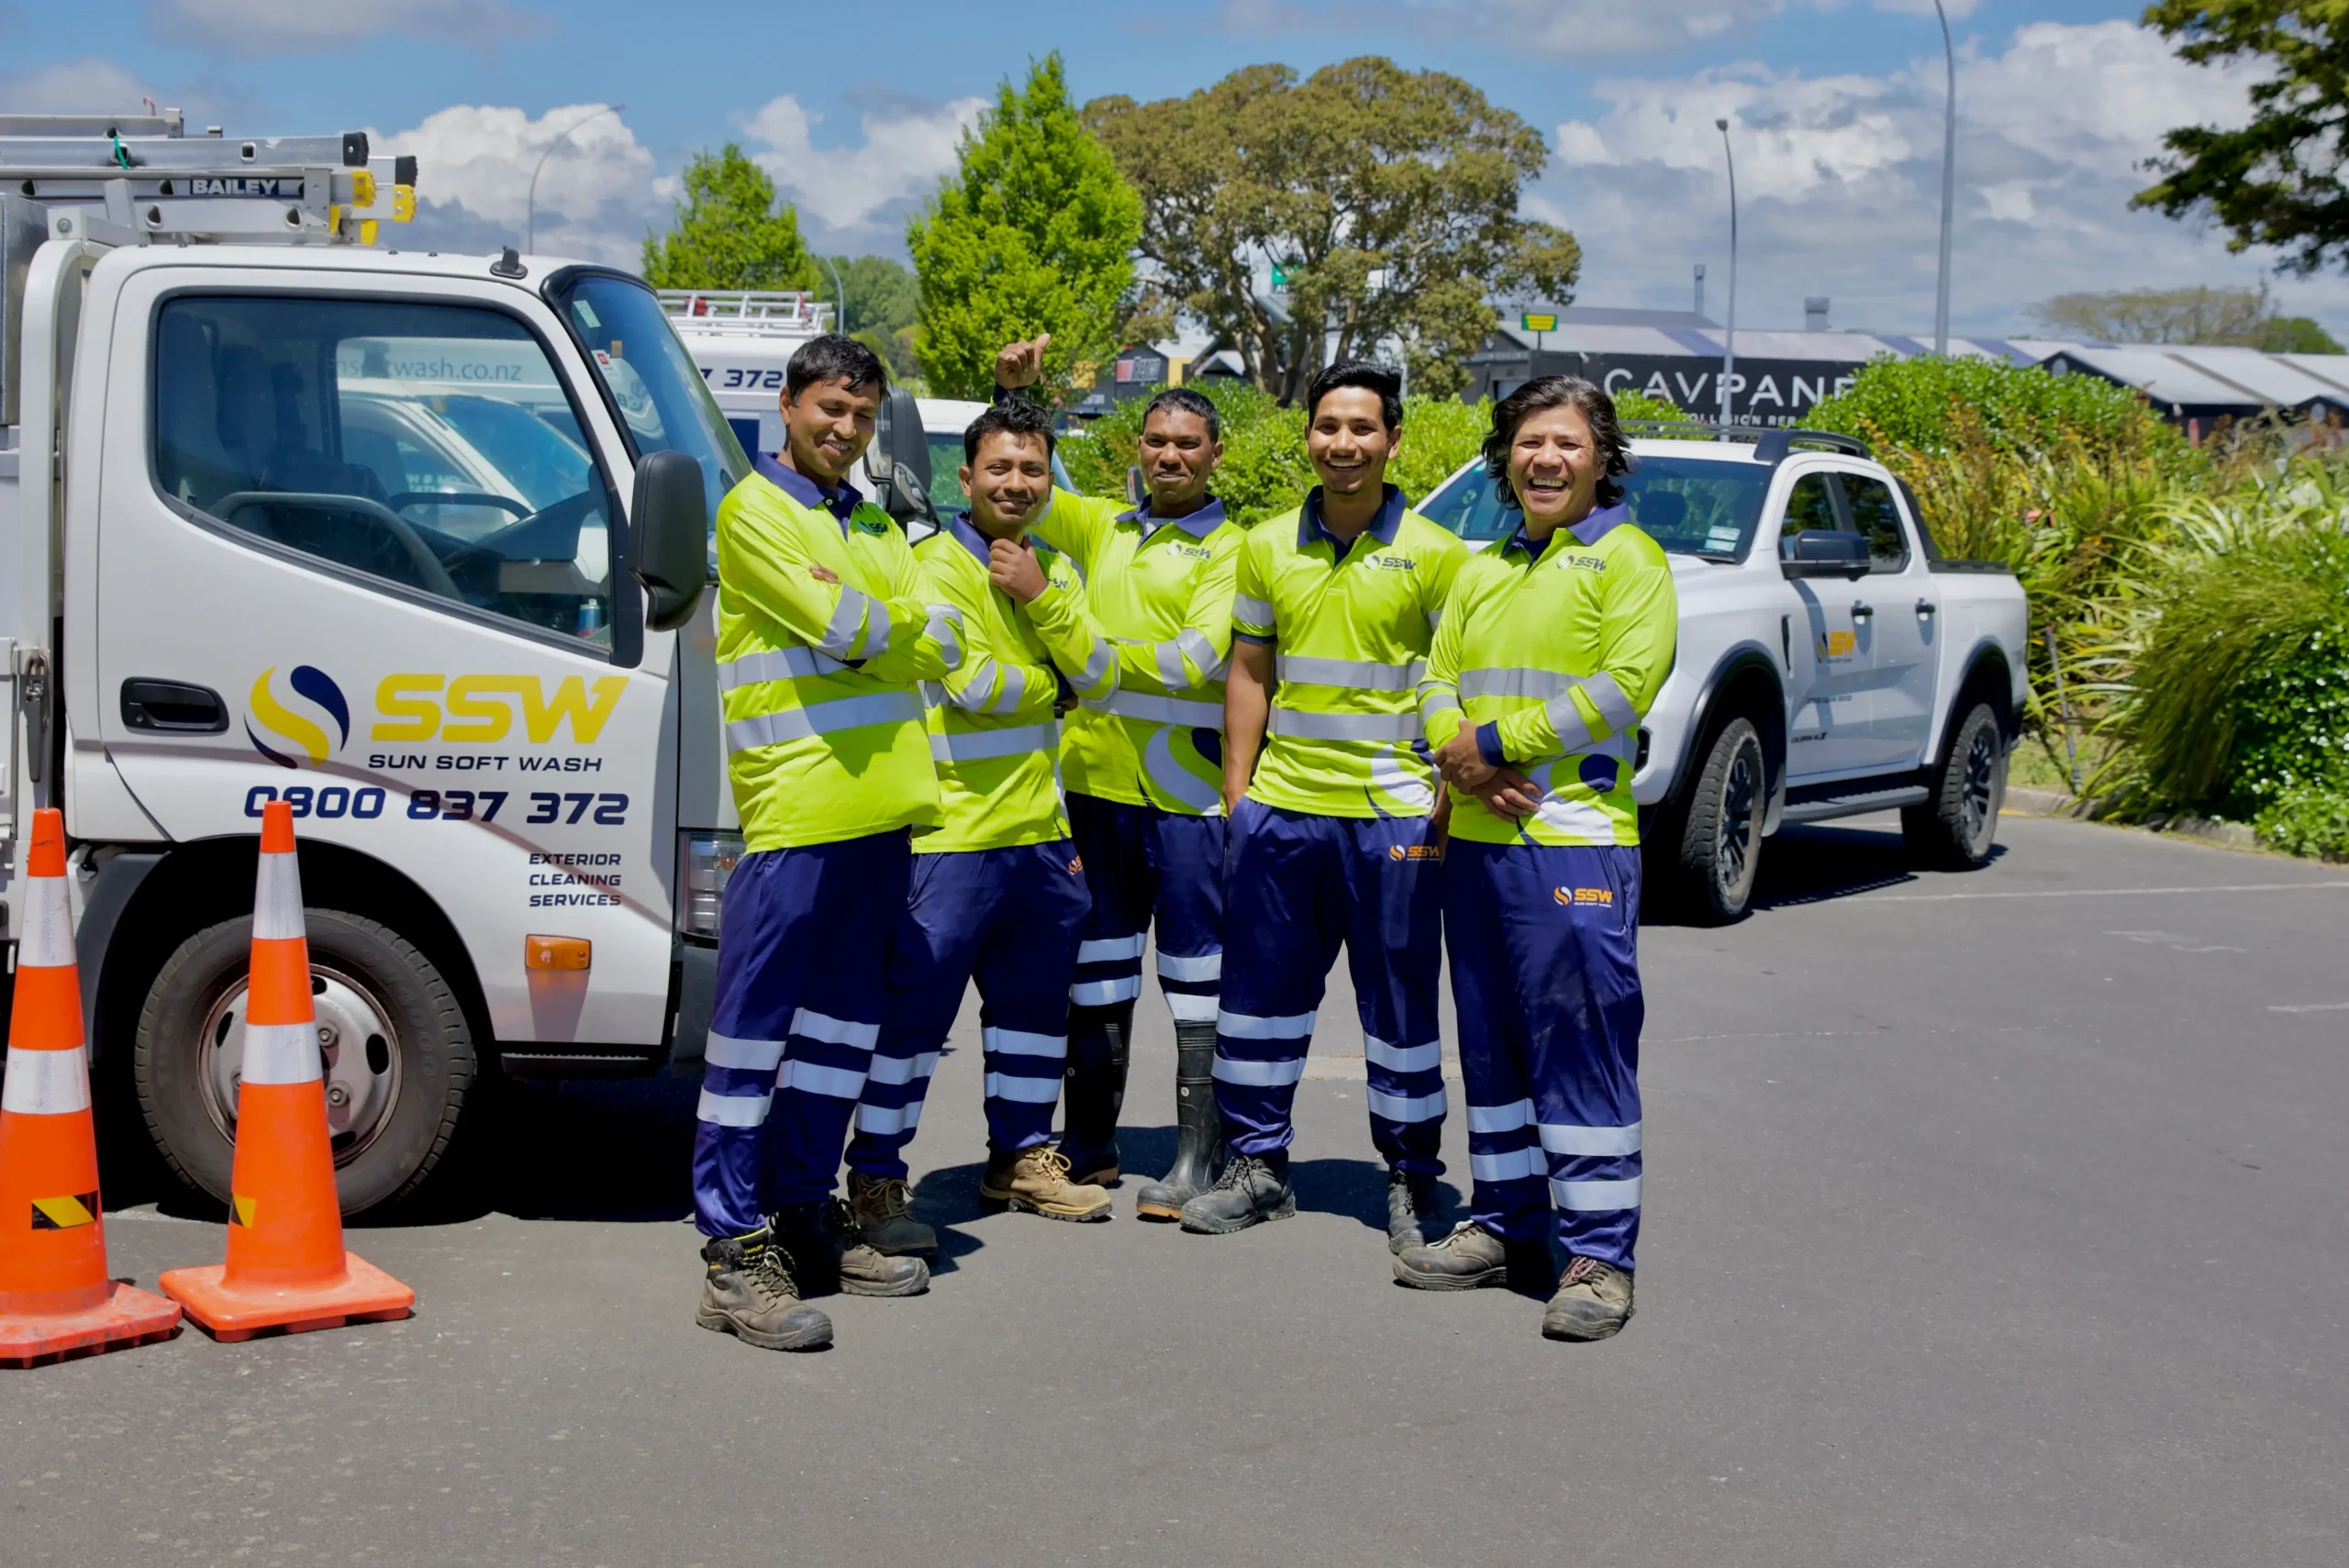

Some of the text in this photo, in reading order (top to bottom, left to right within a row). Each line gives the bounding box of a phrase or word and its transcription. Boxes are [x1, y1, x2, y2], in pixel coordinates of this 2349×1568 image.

[192, 179, 277, 195] BAILEY
[723, 369, 784, 389] 372
[1603, 368, 1858, 406] CAVPANE
[1382, 557, 1418, 570] SSW
[371, 673, 630, 744] SSW
[368, 754, 603, 773] SUN SOFT WASH
[244, 785, 629, 826] 0800 837 372
[529, 853, 621, 865] EXTERIOR
[1407, 845, 1440, 858] SSW
[529, 873, 621, 886] CLEANING
[529, 894, 621, 907] SERVICES
[1574, 887, 1613, 904] SSW
